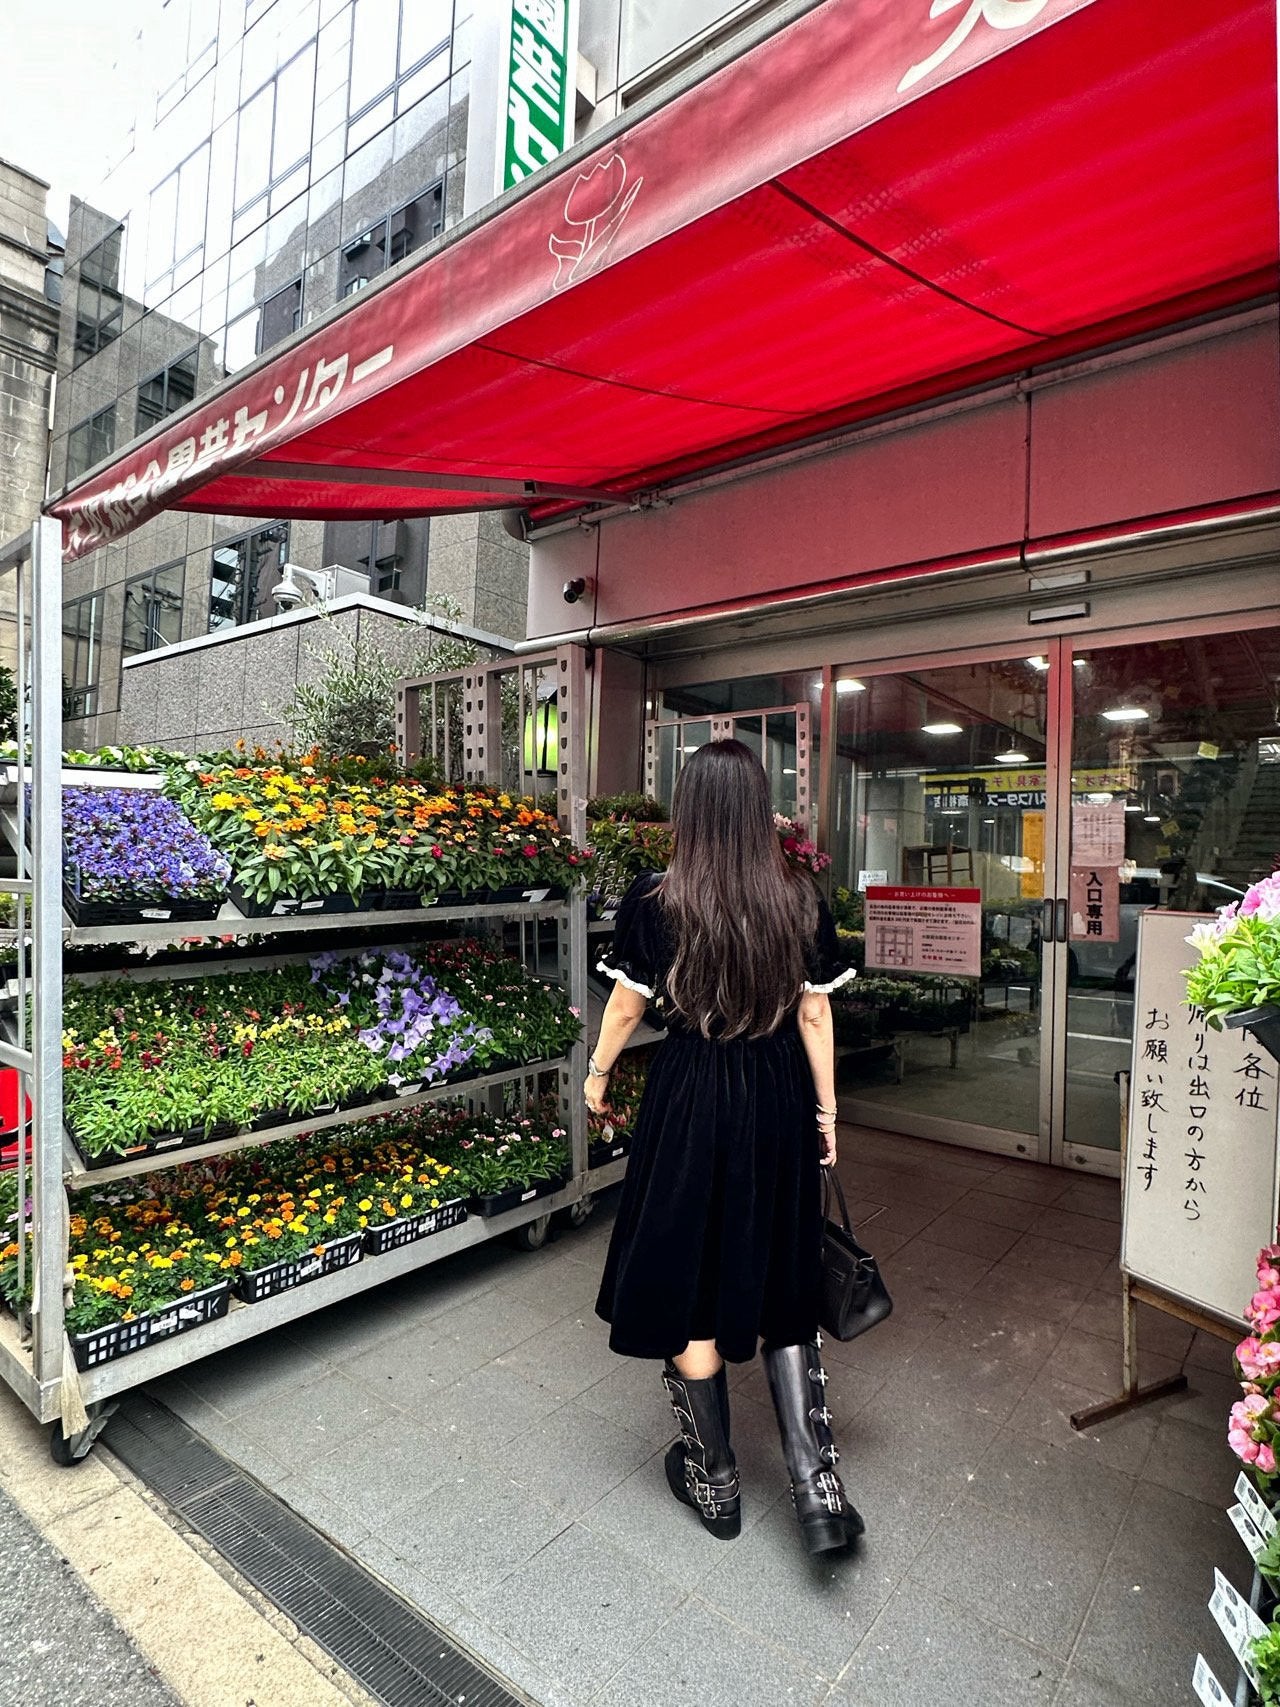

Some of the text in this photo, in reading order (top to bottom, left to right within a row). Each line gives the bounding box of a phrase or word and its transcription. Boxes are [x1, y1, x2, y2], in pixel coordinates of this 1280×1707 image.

[1086, 871, 1103, 936] 入口専用
[1137, 1008, 1170, 1191] お願い致します
